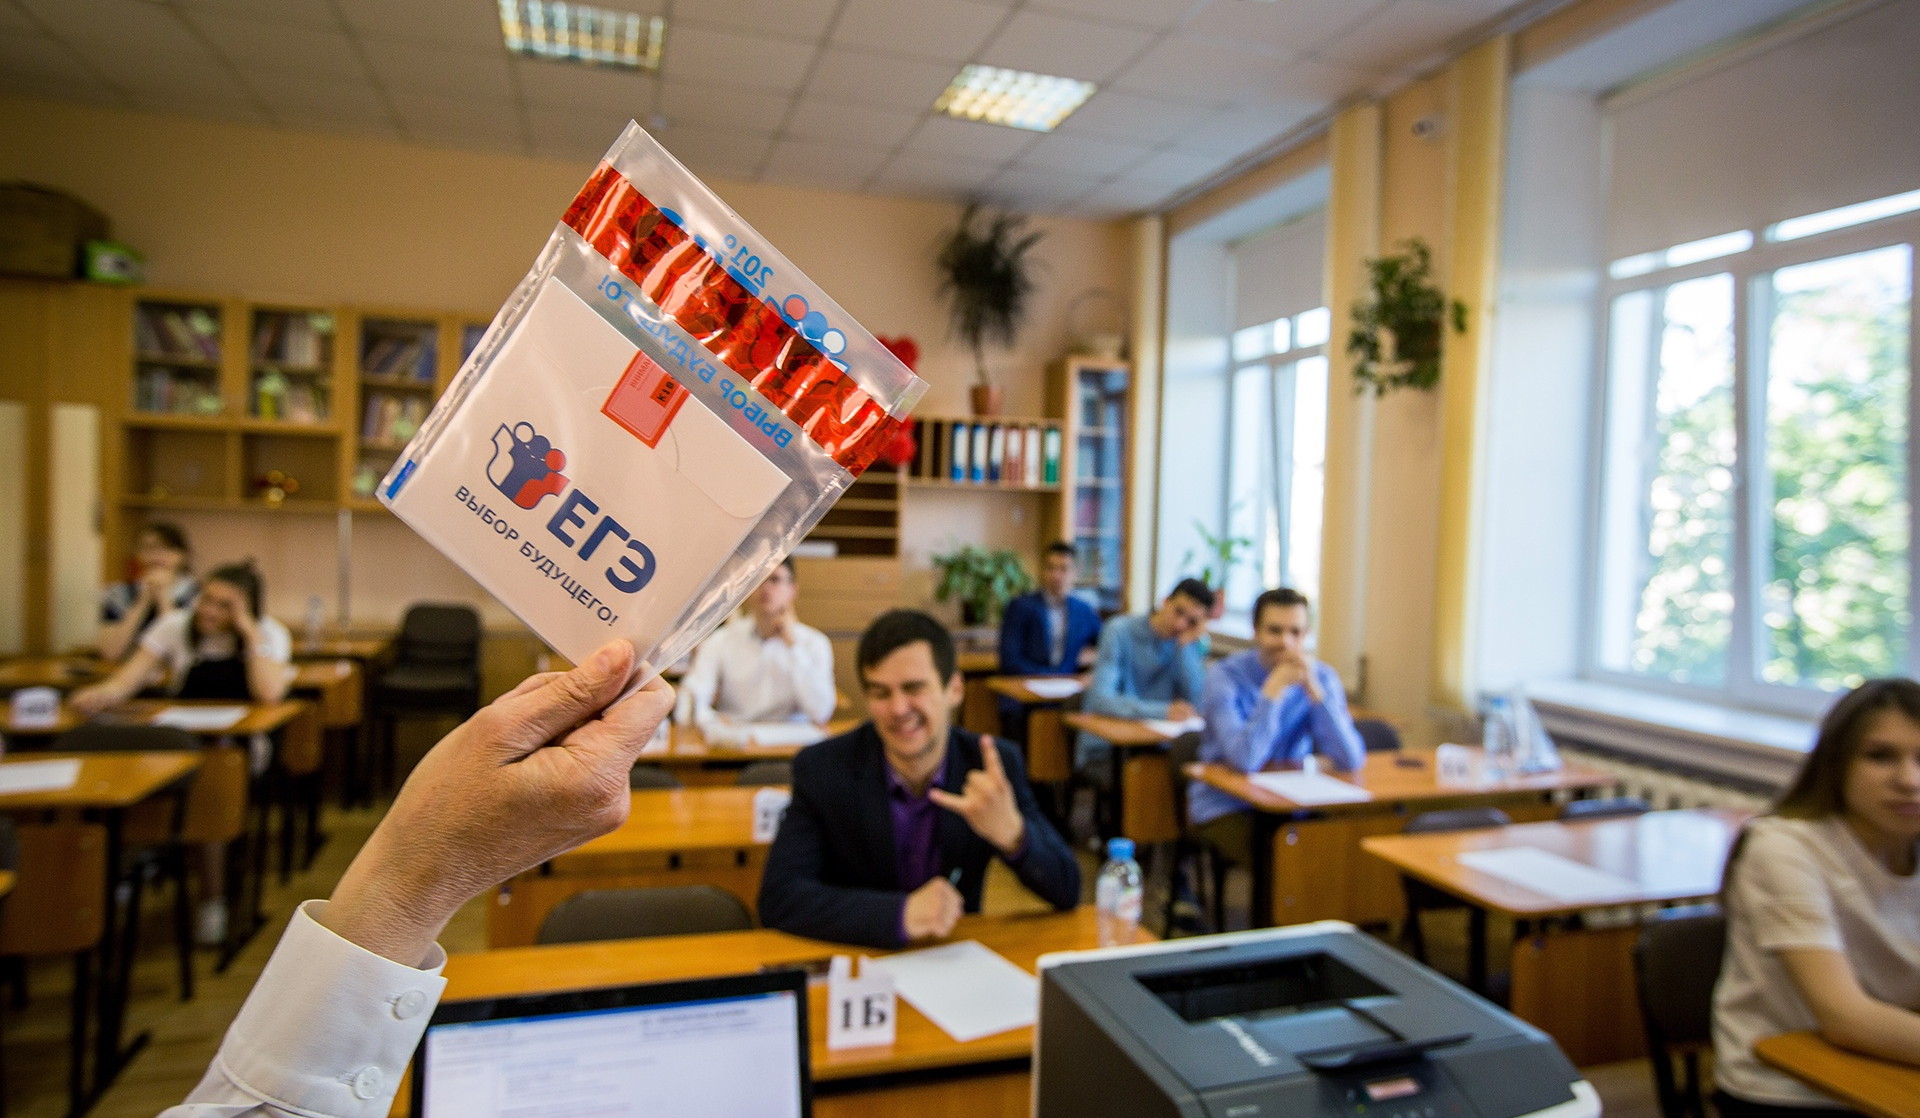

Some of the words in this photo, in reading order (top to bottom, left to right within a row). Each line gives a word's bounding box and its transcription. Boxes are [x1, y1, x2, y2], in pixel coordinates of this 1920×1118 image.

[630, 358, 652, 388] ВНИМА
[454, 485, 520, 541] ВЫБОР
[518, 540, 619, 627] БУДУЩЕГО!
[546, 488, 657, 595] ЕГЭ
[842, 992, 888, 1030] 1Б
